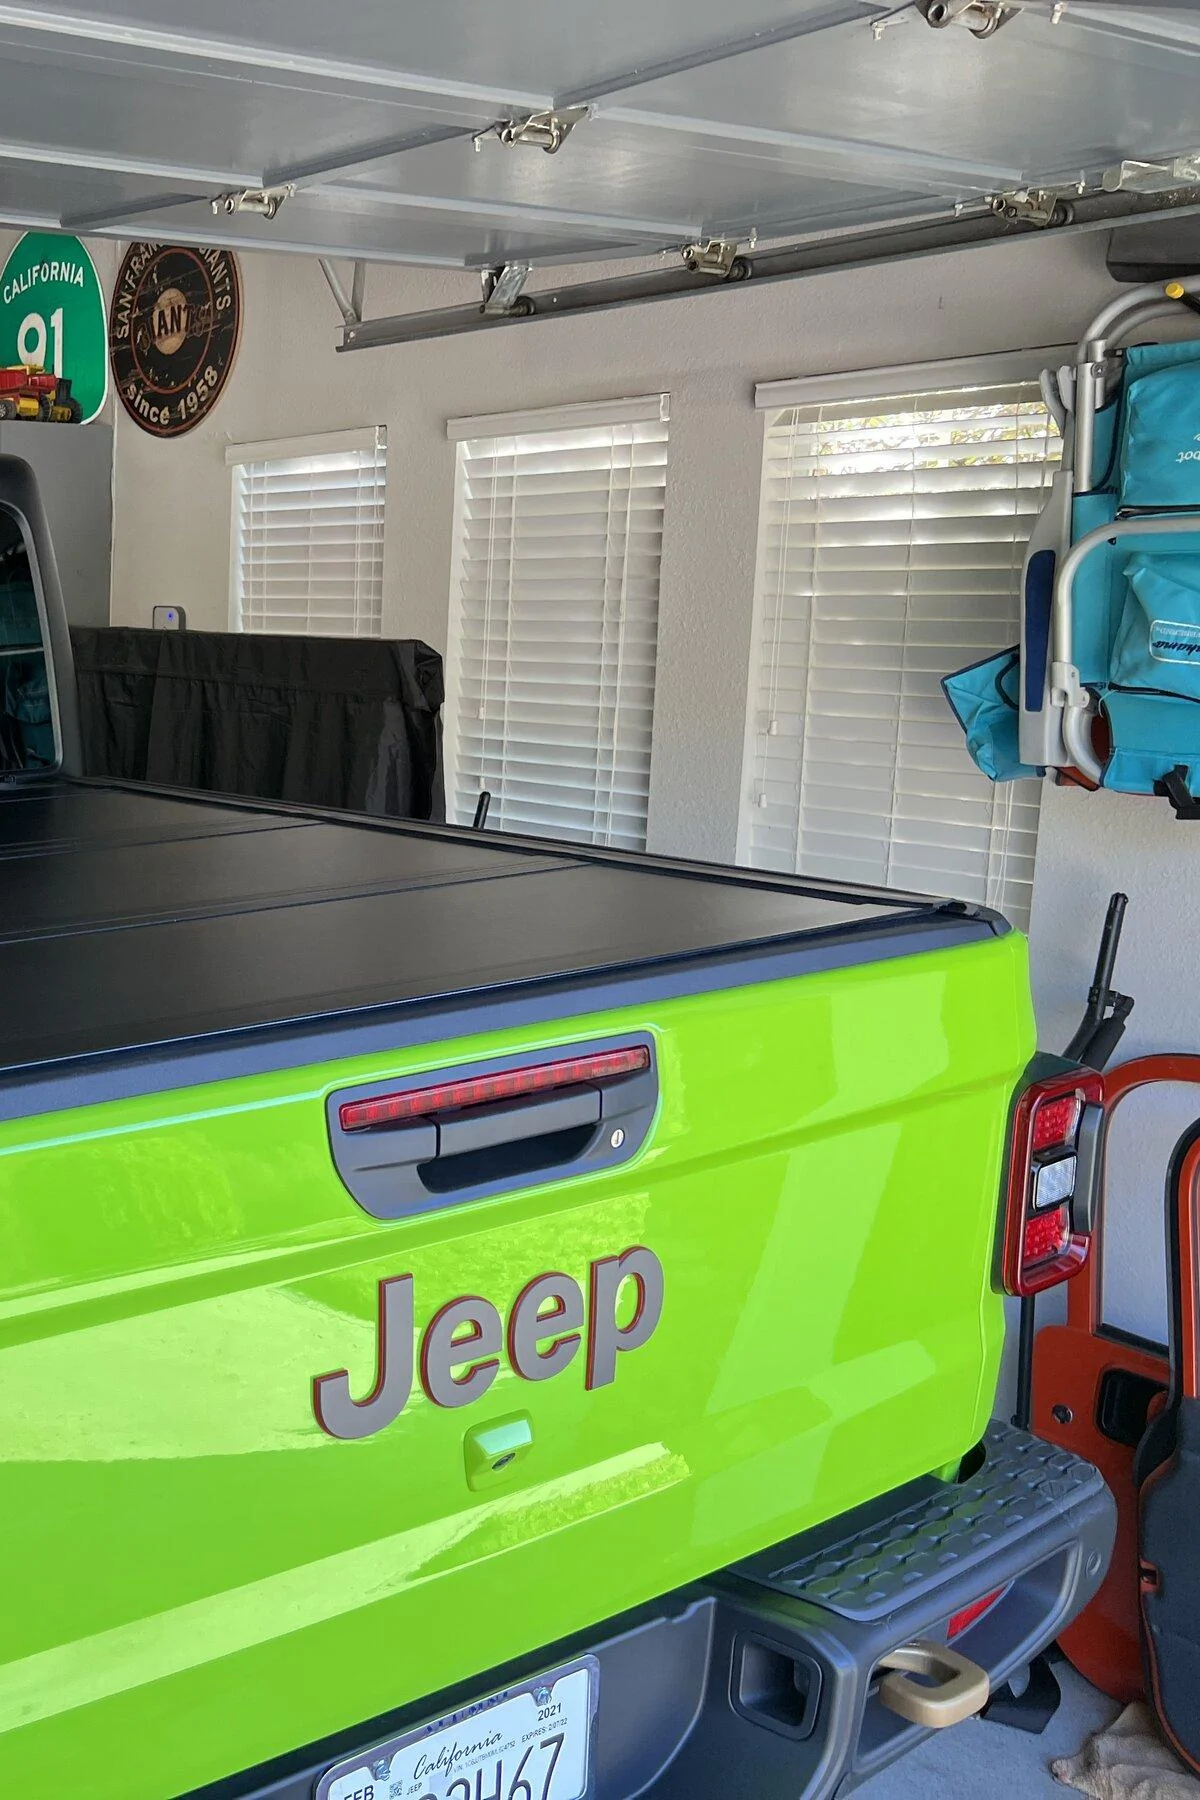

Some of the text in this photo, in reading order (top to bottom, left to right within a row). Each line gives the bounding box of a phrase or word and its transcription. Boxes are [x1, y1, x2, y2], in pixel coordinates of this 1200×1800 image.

[3, 261, 85, 304] CALIFORNIA
[117, 291, 133, 338] SAN
[17, 308, 63, 378] 91
[178, 365, 218, 420] 1958
[312, 1245, 664, 1439] Jeep
[538, 1703, 562, 1721] 2021
[413, 1731, 503, 1778] California
[406, 1782, 423, 1796] JEEP
